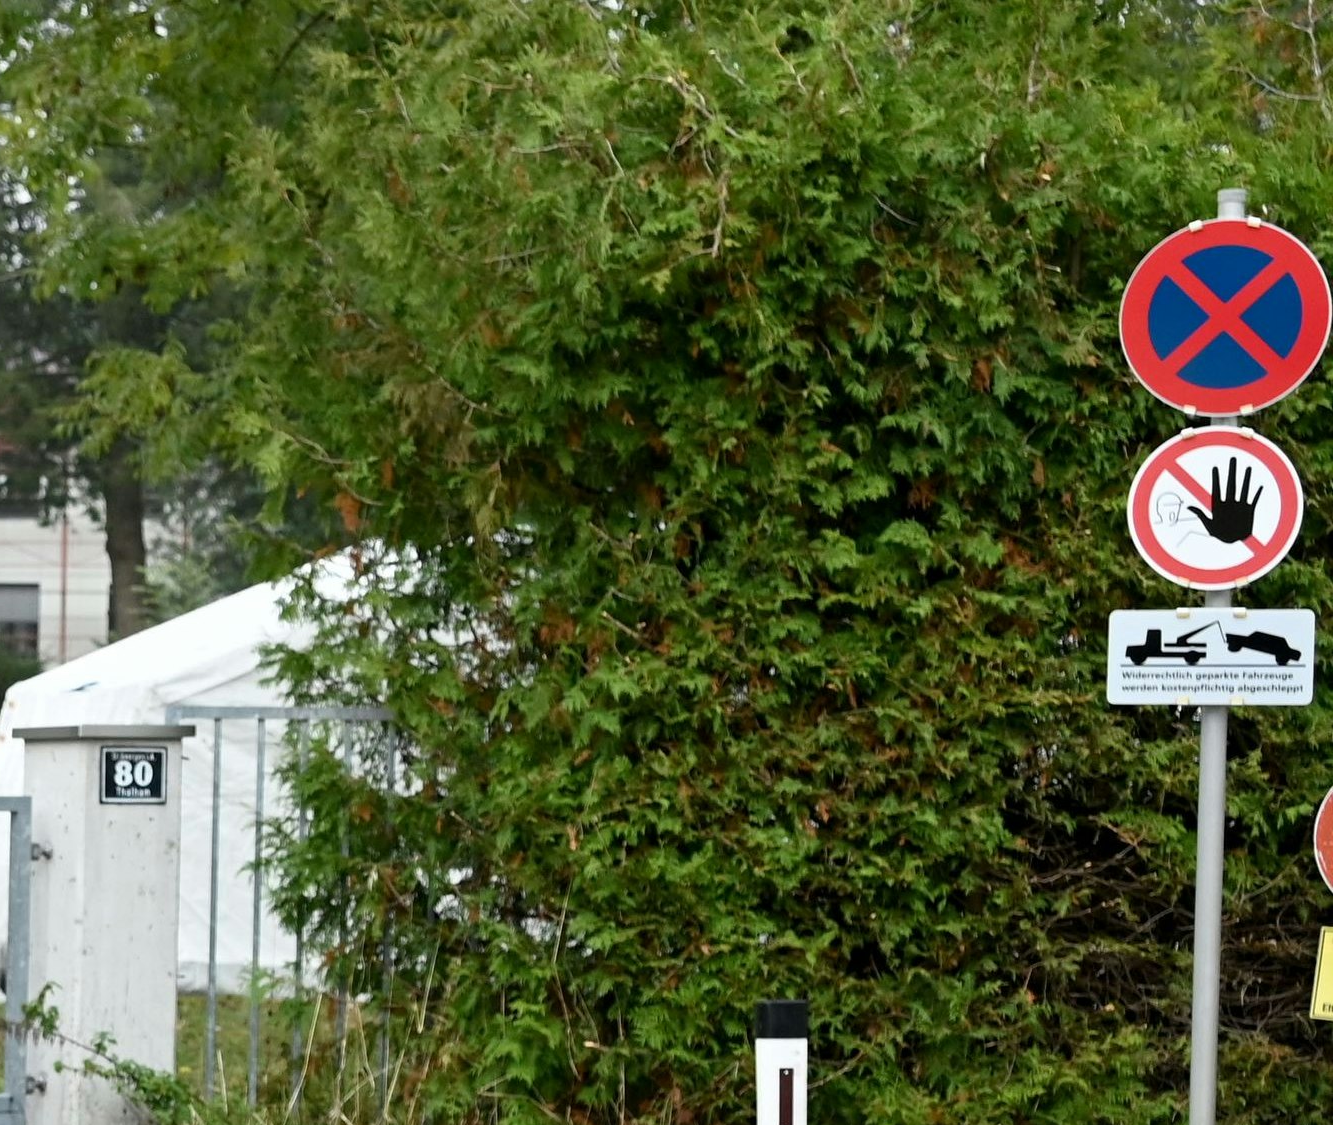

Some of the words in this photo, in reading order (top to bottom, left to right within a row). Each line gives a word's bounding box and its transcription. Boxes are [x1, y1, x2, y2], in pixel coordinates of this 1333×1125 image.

[1122, 671, 1192, 680] Widerrechtlich
[1195, 671, 1239, 682] geparkte
[1242, 671, 1294, 682] Fahrzeuge
[1121, 684, 1159, 692] werden
[1161, 684, 1235, 694] kostenpflichtig
[1237, 684, 1304, 694] abgeschleppt
[113, 760, 153, 787] 80
